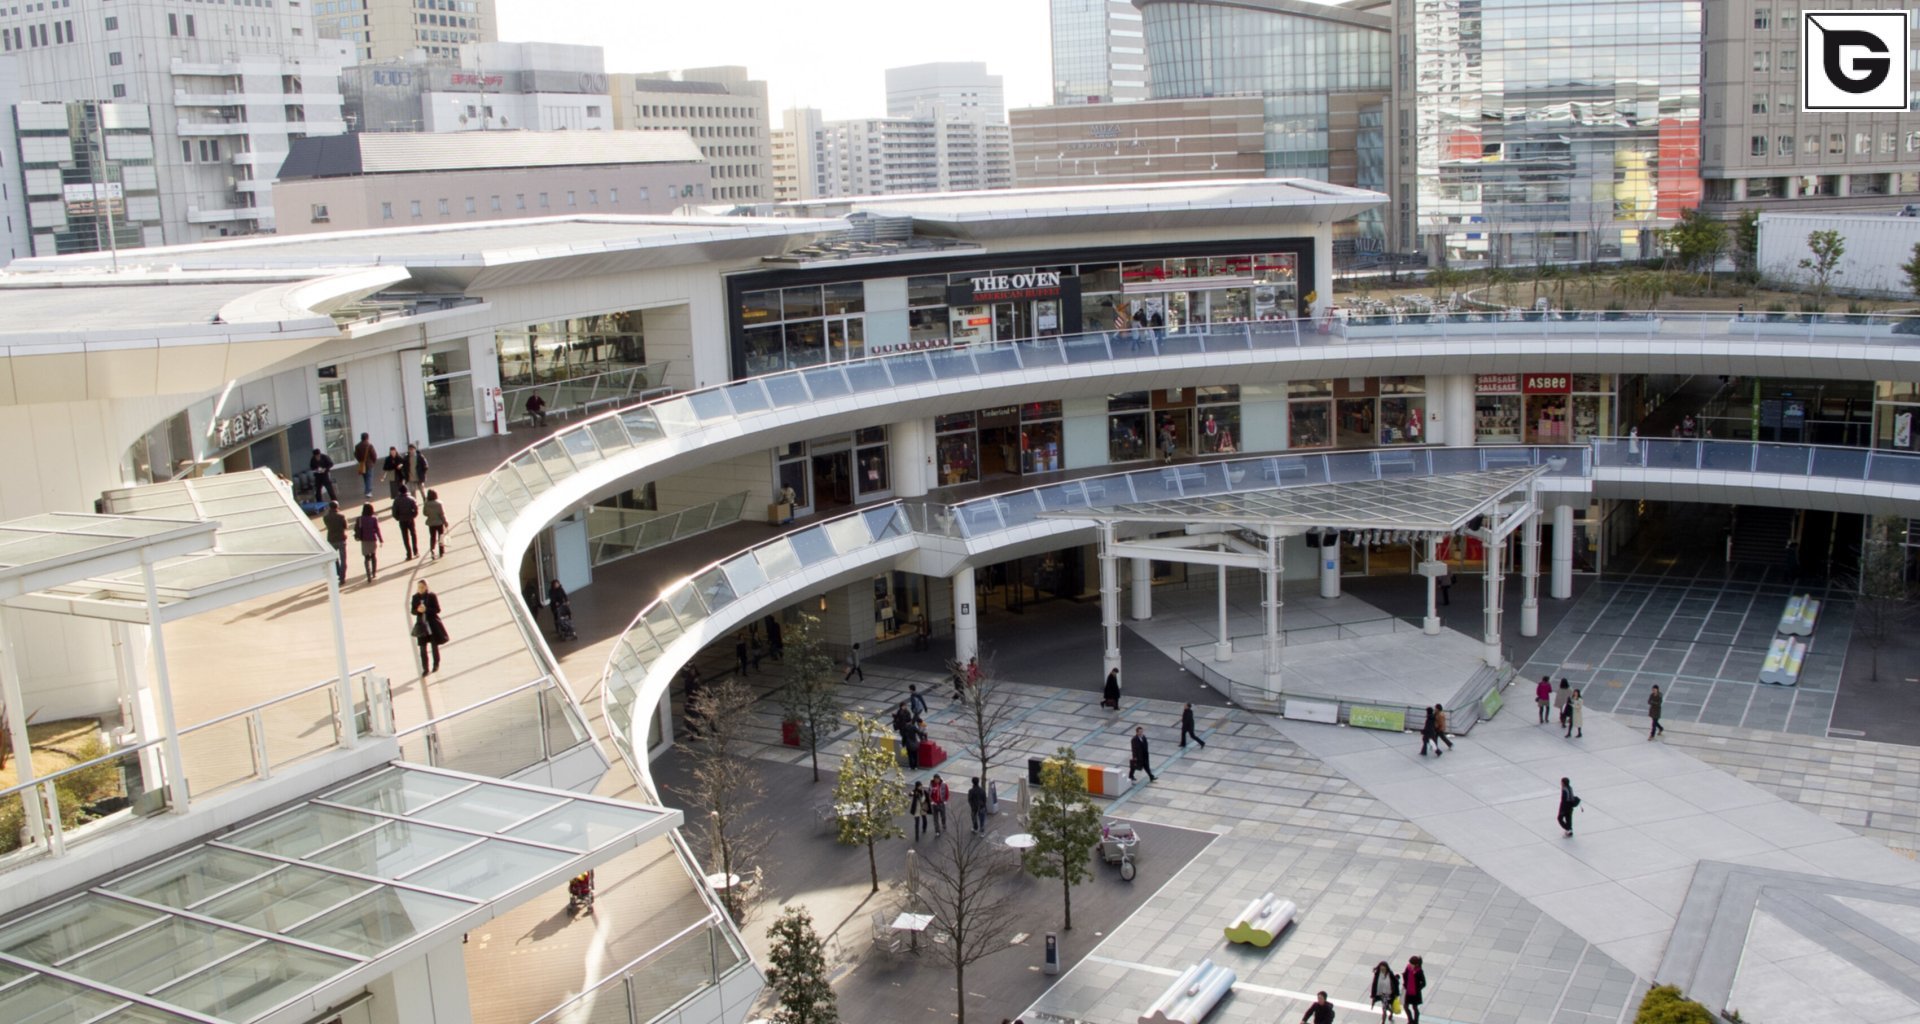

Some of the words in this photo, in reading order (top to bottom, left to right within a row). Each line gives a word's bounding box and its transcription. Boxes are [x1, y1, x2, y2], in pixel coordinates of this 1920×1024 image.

[681, 184, 694, 198] JR
[1354, 238, 1384, 253] MUZA
[970, 275, 1010, 292] THE
[1011, 271, 1062, 290] OVEN
[972, 291, 1024, 301] AMERICAN
[1024, 287, 1061, 298] BUFFET
[982, 407, 1010, 417] Timberland
[1352, 714, 1387, 724] LAZONA
